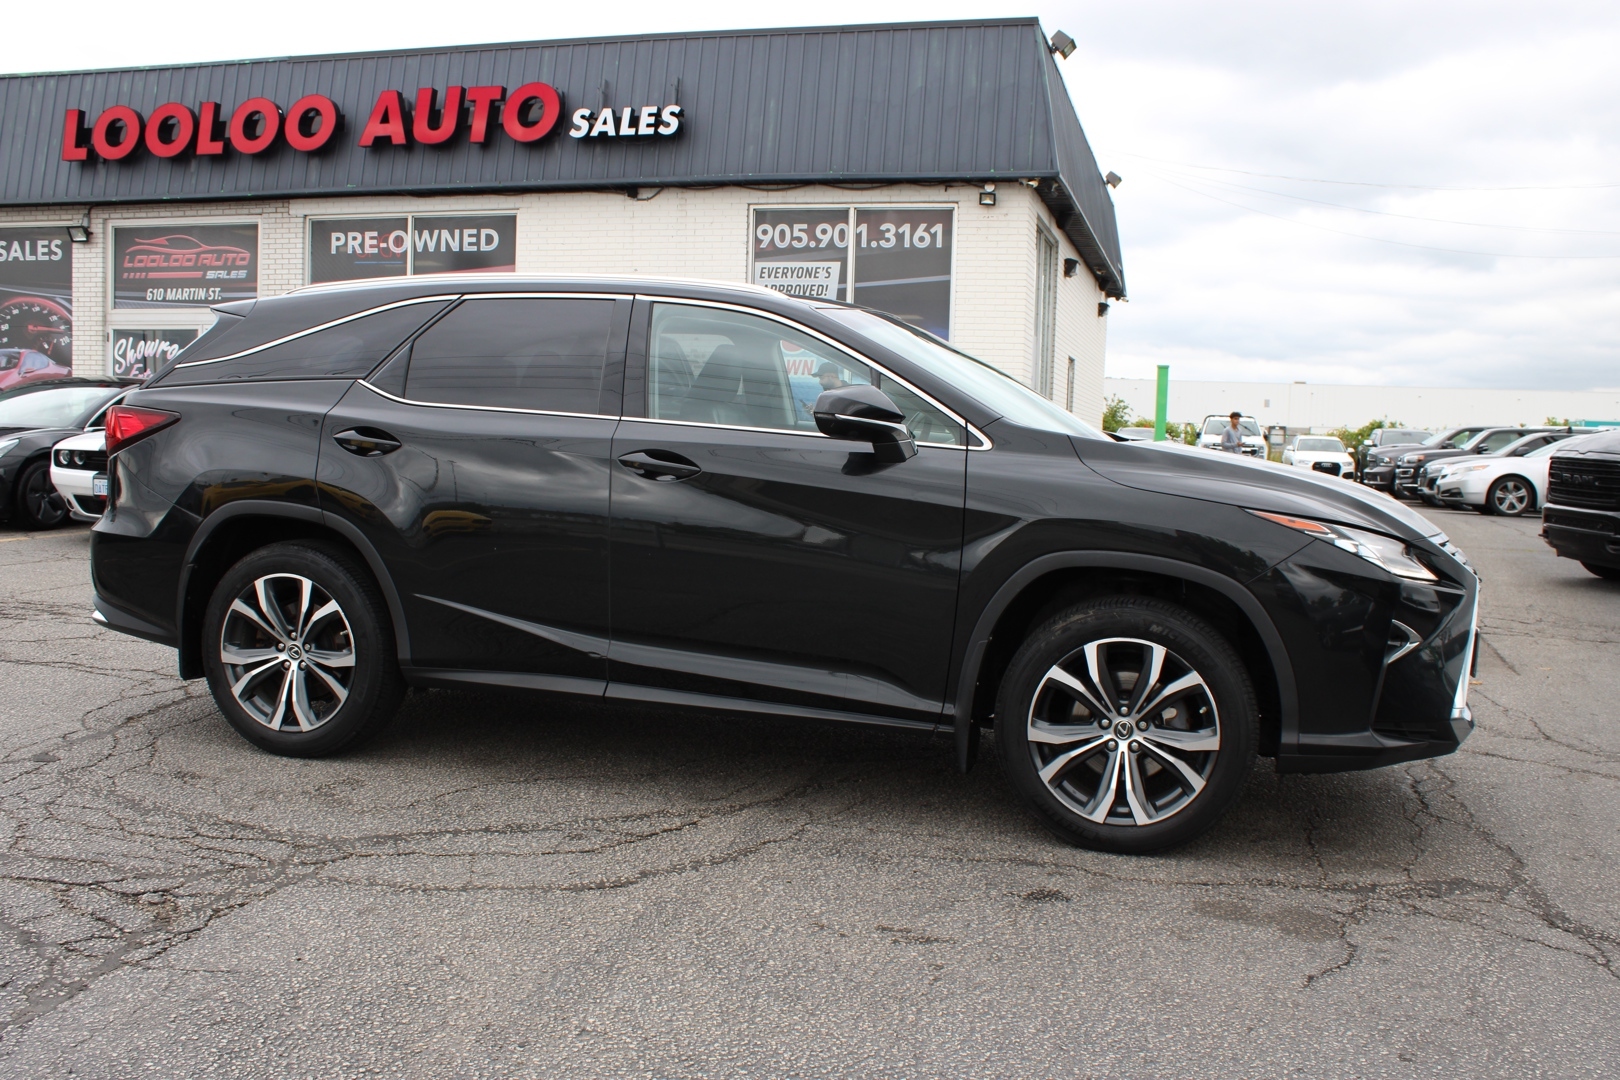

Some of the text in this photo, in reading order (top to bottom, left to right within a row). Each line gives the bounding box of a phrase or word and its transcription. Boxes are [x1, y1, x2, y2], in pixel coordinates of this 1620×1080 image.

[62, 81, 684, 162] LOOLOO AUTO SALES
[330, 228, 500, 255] PRE-OWNED
[756, 223, 943, 249] 905.901.3161
[0, 239, 63, 262] SALES
[123, 253, 251, 268] LOOLOO AUTO
[205, 269, 248, 279] SALES
[759, 266, 832, 279] EVERYONE'S
[146, 287, 222, 301] 610 MARTIN ST.
[764, 284, 829, 297] PPROVED!
[114, 336, 184, 374] Showro
